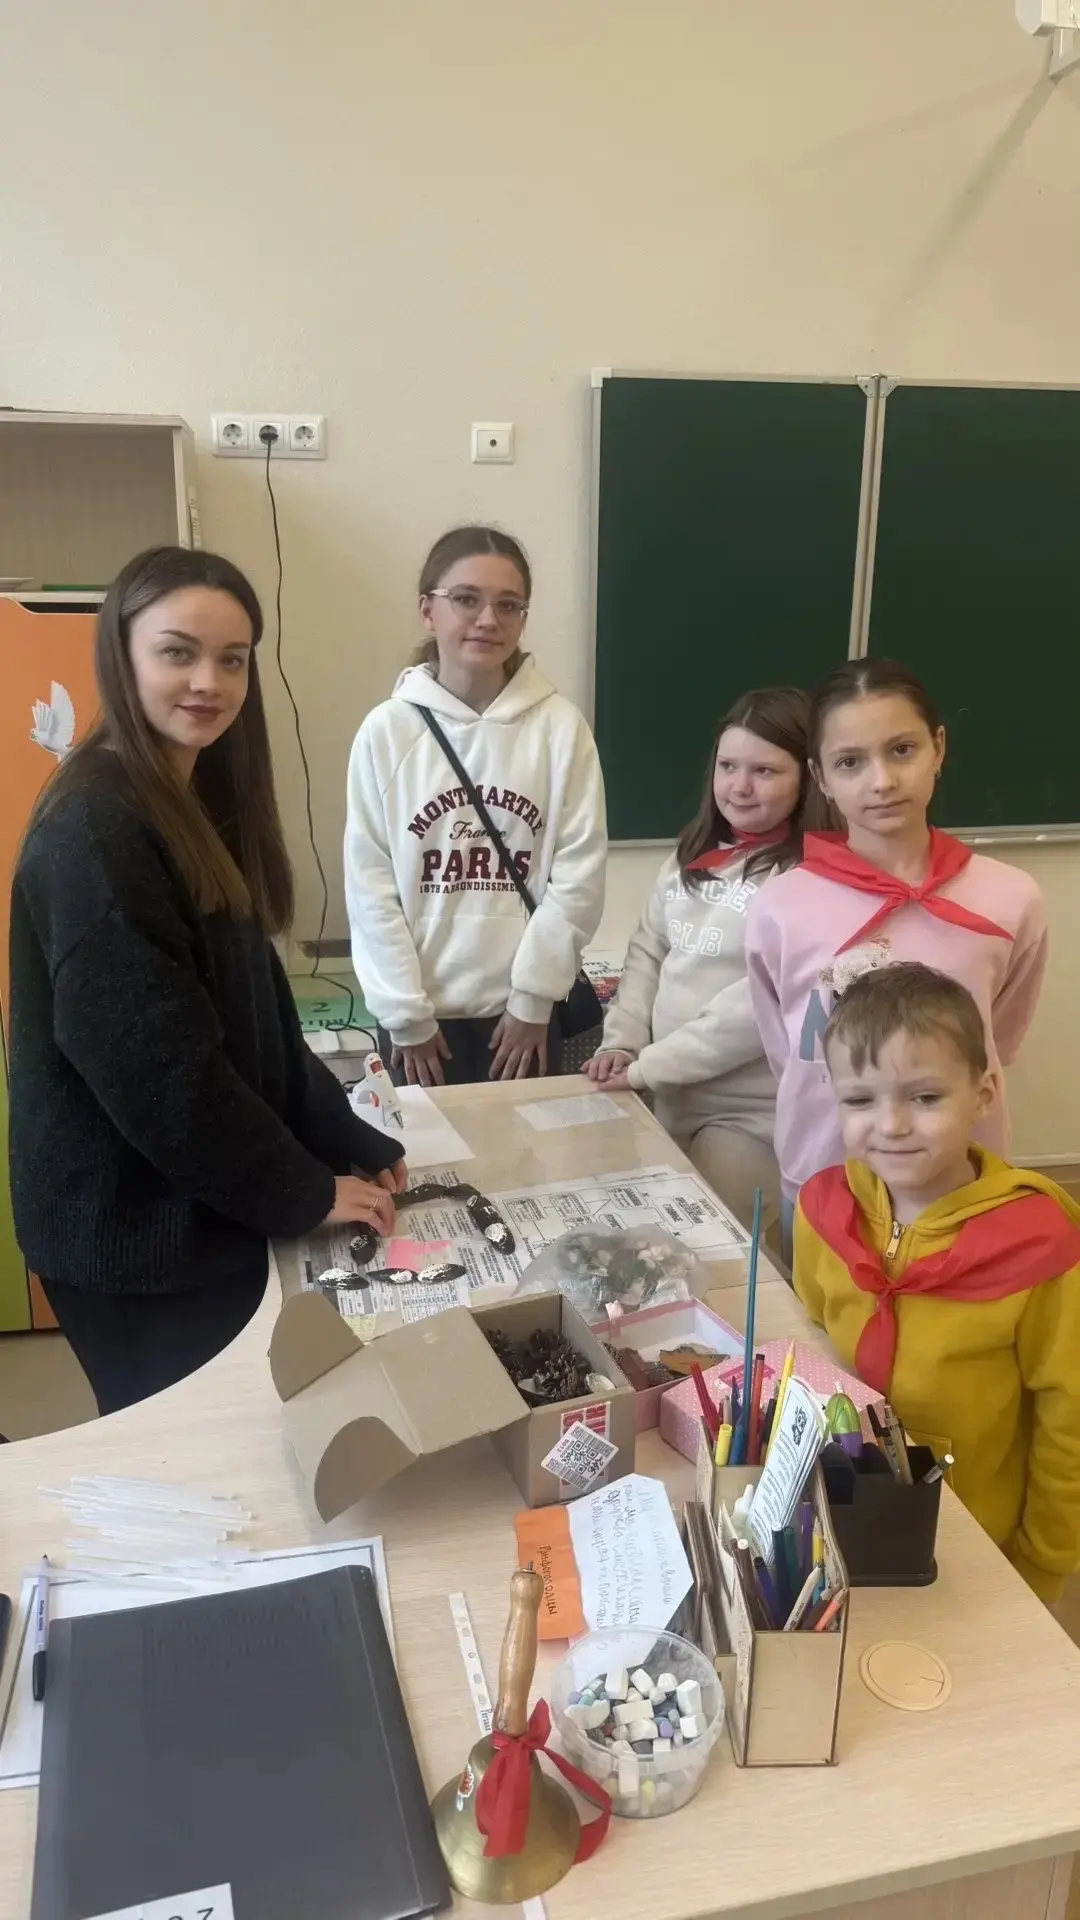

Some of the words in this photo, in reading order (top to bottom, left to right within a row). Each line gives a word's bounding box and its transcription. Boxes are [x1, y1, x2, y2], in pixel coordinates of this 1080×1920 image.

[449, 820, 508, 840] Frane
[421, 847, 531, 882] PARIS
[443, 881, 519, 894] ARRONDISSEME
